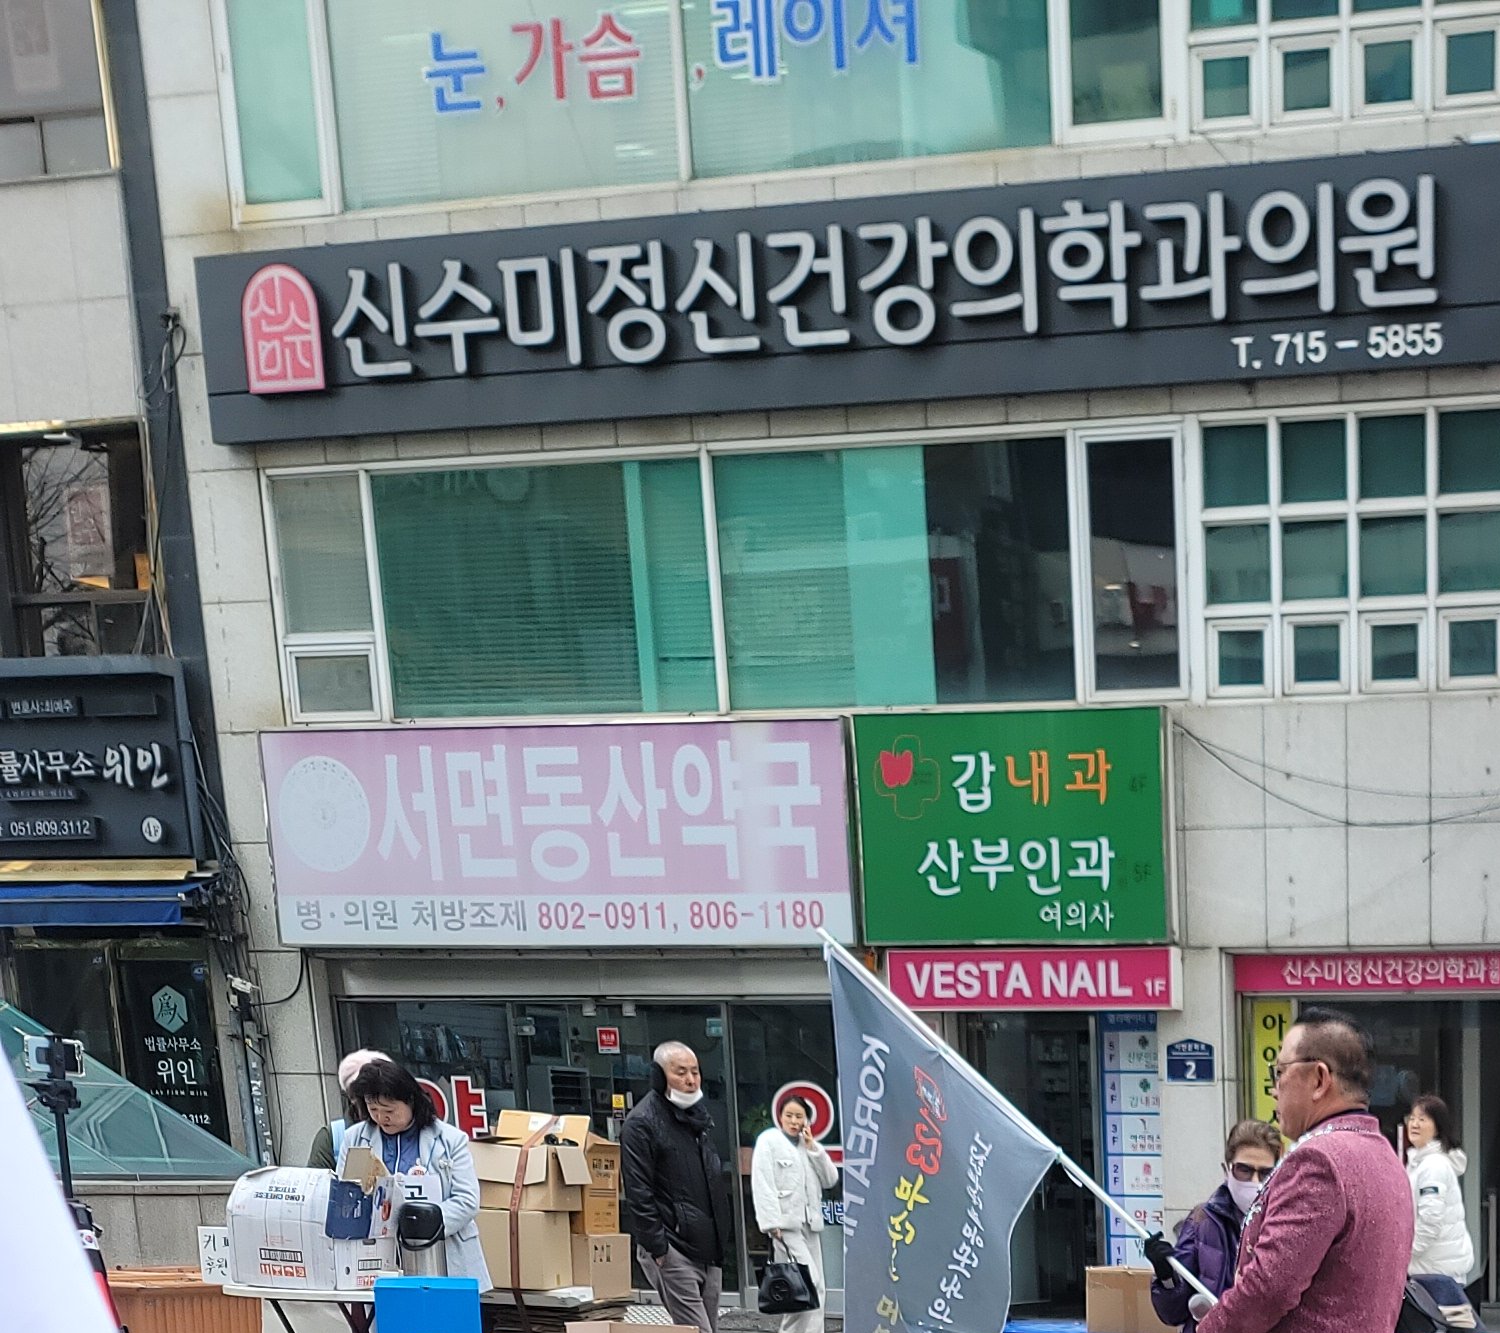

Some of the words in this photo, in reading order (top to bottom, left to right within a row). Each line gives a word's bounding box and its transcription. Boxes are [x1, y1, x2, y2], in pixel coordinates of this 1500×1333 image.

[331, 173, 1439, 379] 신수미정신건강의학과의원
[9, 819, 91, 837] 051.809.3112
[376, 739, 823, 884] 서면동산약국
[916, 835, 1116, 898] 산부인과
[411, 899, 528, 933] 처방조제
[689, 899, 825, 932] 806-1180
[1038, 899, 1115, 933] 여의사
[904, 960, 1040, 1000] VESTA
[1041, 958, 1134, 999] NAIL
[1143, 977, 1167, 998] 1F
[156, 1057, 199, 1086] 위인
[1184, 1060, 1198, 1080] 2
